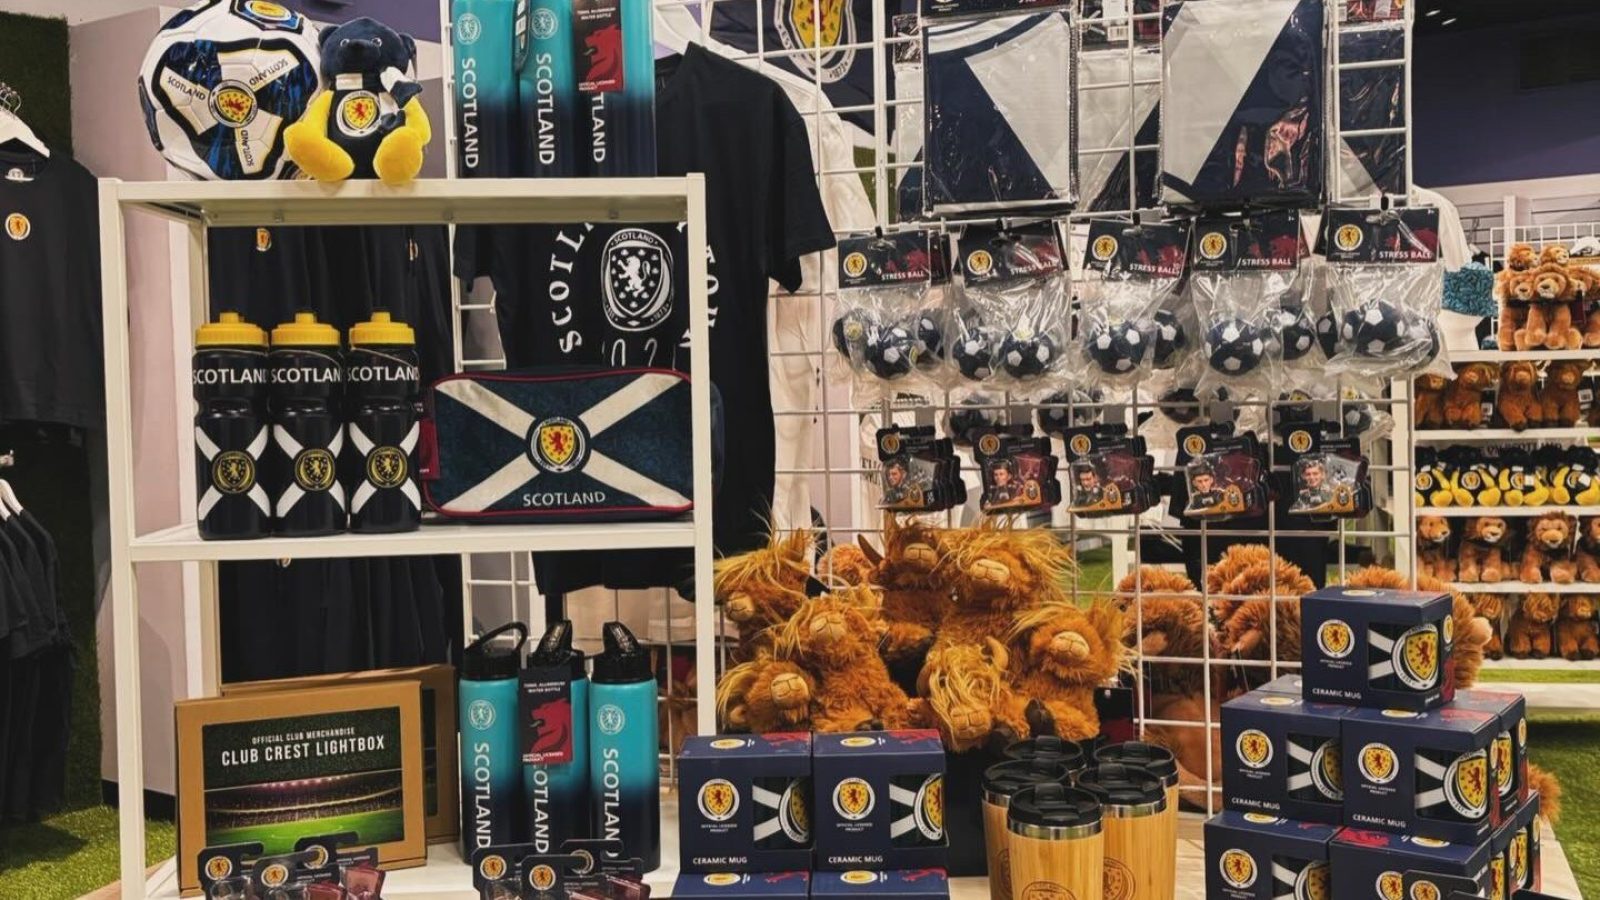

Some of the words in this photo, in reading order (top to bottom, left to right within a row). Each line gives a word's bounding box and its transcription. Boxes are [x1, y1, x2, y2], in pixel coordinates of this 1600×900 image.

[249, 58, 289, 86] SCOTLAND
[168, 76, 206, 101] SCOTLAND
[461, 57, 479, 168] SCOTLAND
[536, 53, 555, 165] SCOTLAND
[591, 91, 606, 163] TLAND
[240, 129, 255, 168] SCOTLAND
[614, 232, 654, 244] SCOTLAND
[1241, 258, 1270, 266] STRESS
[1272, 258, 1291, 266] BALL
[1380, 251, 1409, 259] STRESS
[1411, 251, 1431, 259] BALL
[881, 272, 906, 281] STRESS
[908, 271, 925, 280] BALL
[1129, 264, 1156, 273] STRESS
[549, 222, 594, 353] SCOTL
[270, 367, 341, 384] SCOTLAN
[522, 491, 606, 507] SCOTLAND
[1312, 687, 1342, 698] CERAMIC
[1344, 689, 1362, 700] MUG
[252, 734, 283, 745] OFFICIAL
[286, 731, 303, 741] CLUB
[306, 727, 355, 740] MERCHANDISE
[221, 748, 259, 767] CLUB
[265, 742, 310, 762] CREST
[316, 735, 385, 756] LIGHTBOX
[474, 742, 491, 848] SCOTLAND
[1231, 797, 1261, 808] CERAMIC
[1263, 802, 1280, 810] MUG
[533, 764, 549, 853] OTLAND
[1352, 813, 1386, 826] CERAMIC
[1387, 819, 1407, 829] MUG
[692, 857, 727, 865] CERAMIC
[728, 856, 748, 864] MUG
[864, 855, 883, 863] MUG
